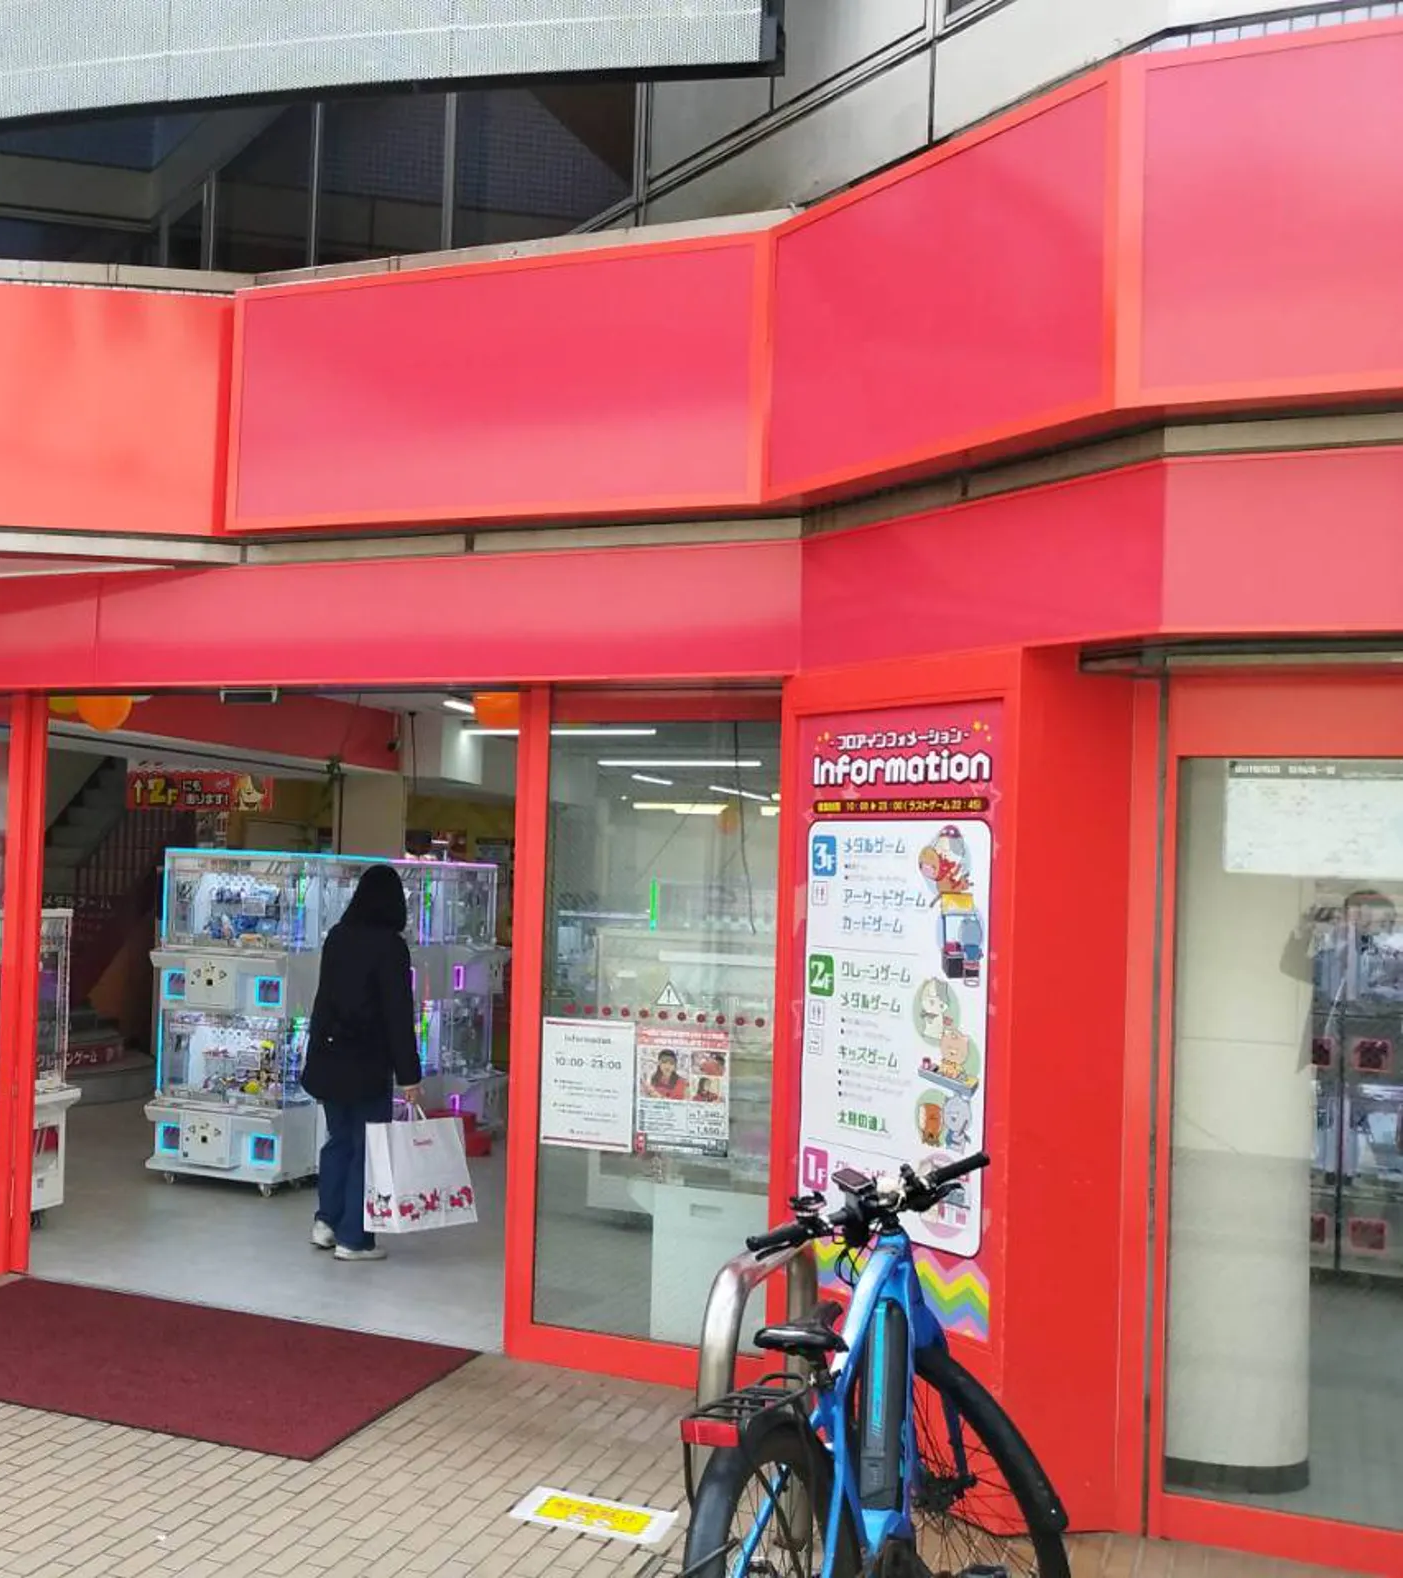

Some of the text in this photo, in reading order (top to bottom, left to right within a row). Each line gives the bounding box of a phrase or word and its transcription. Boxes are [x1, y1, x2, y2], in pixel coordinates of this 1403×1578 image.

[812, 750, 990, 786] Information
[810, 960, 834, 990] 2F
[806, 1154, 827, 1184] 1F
